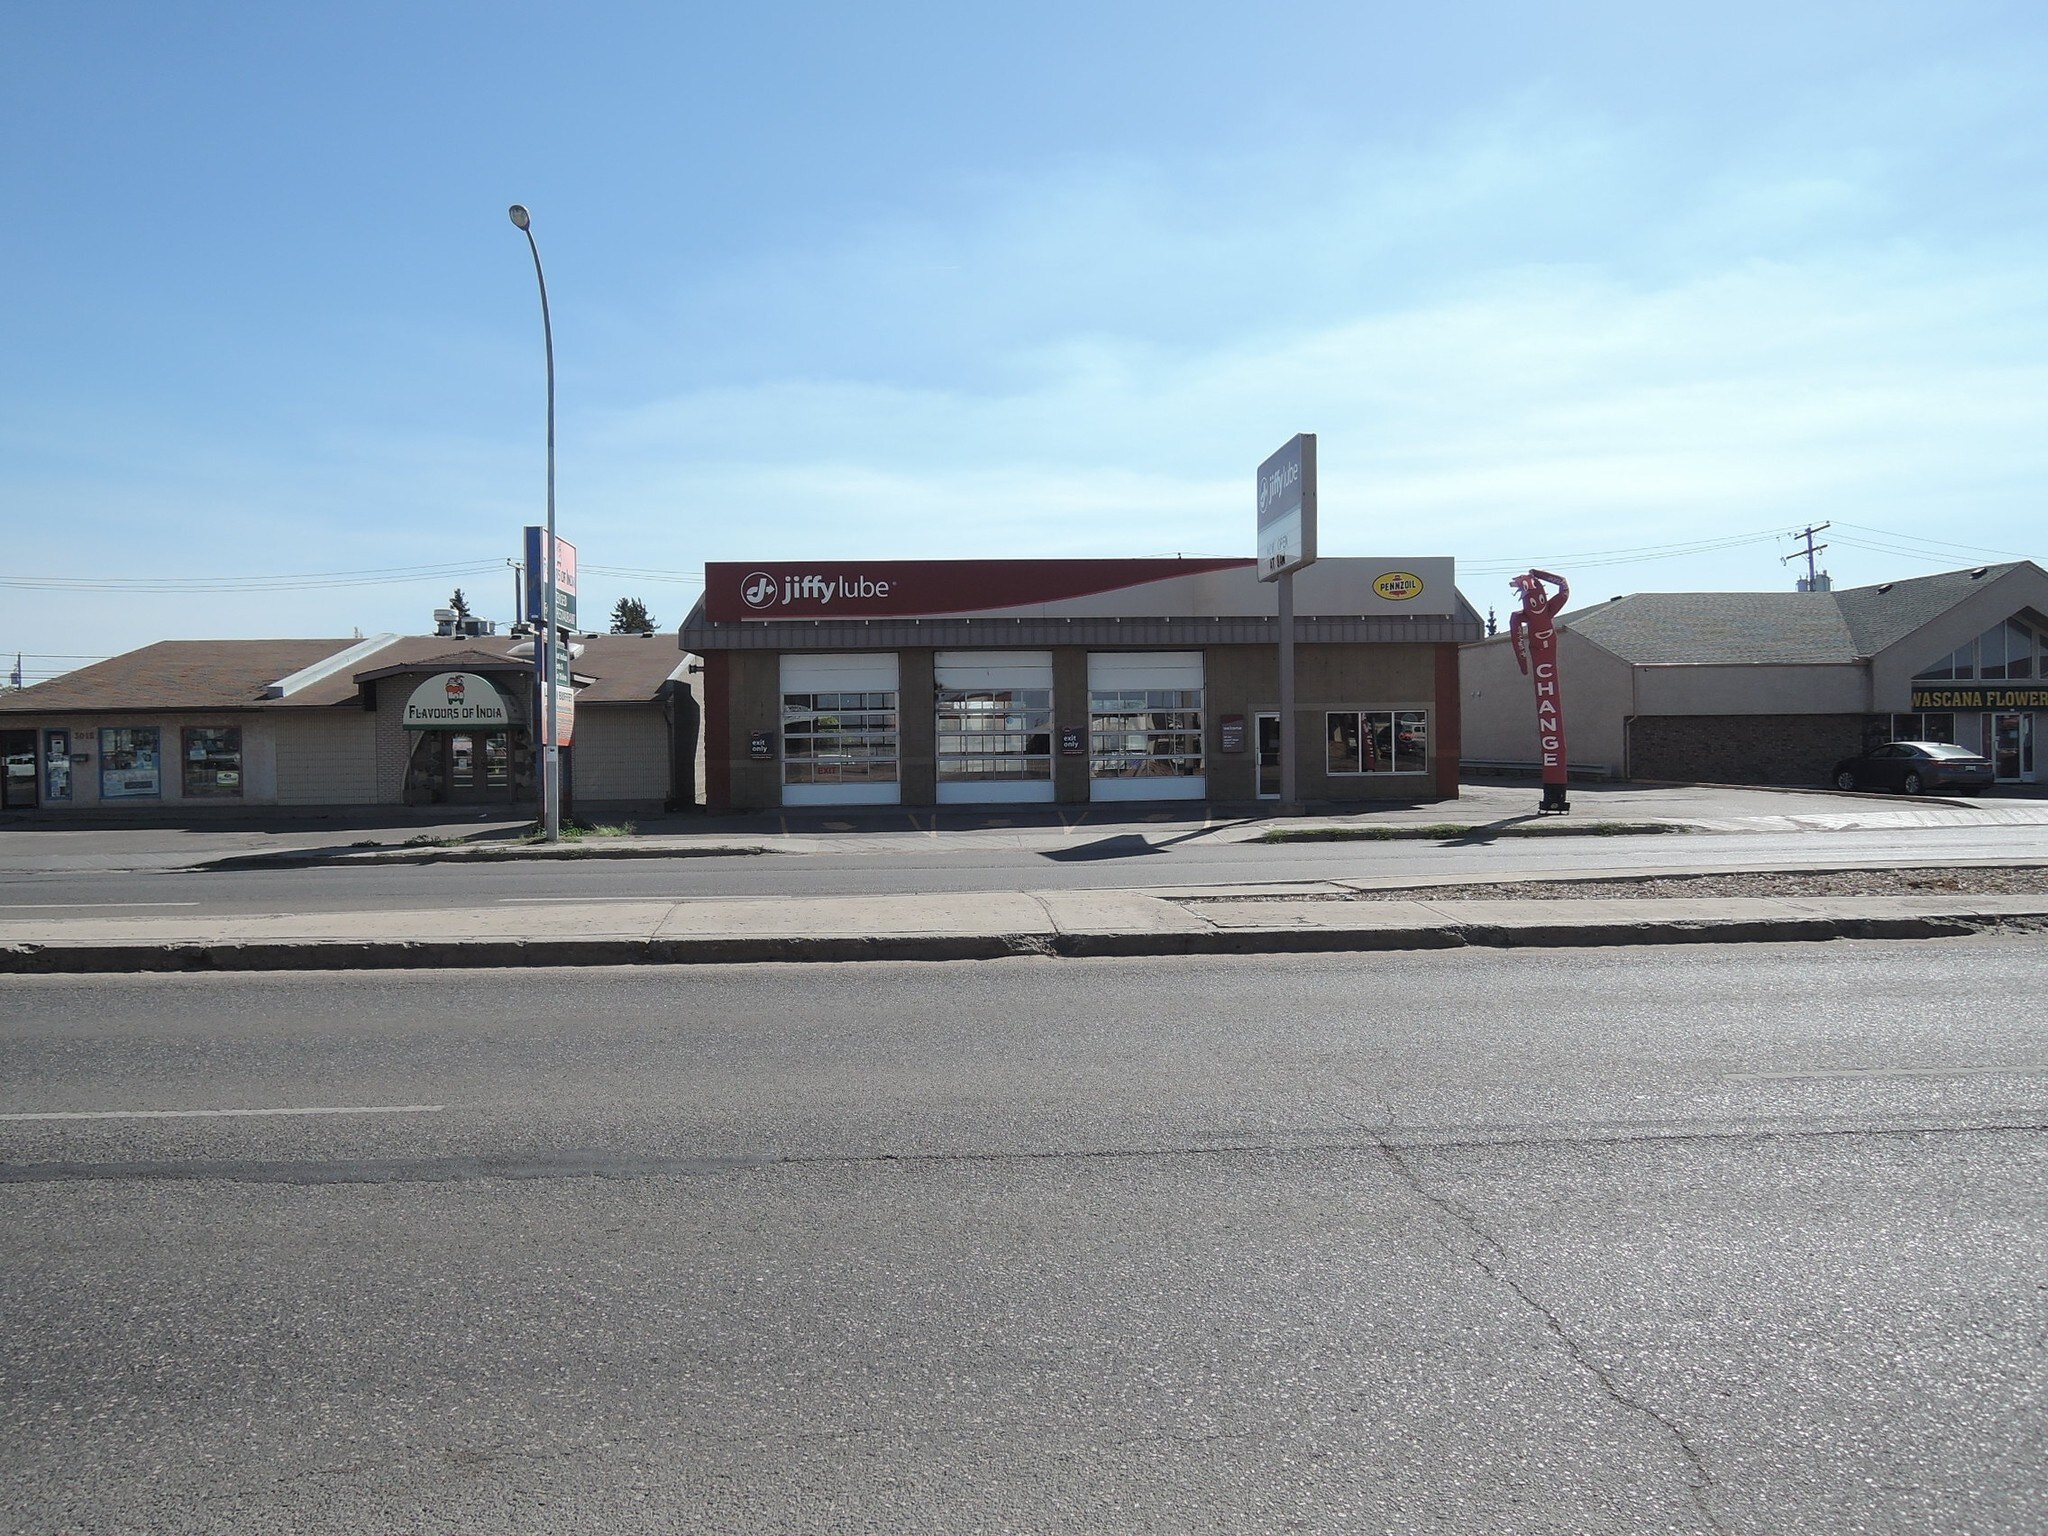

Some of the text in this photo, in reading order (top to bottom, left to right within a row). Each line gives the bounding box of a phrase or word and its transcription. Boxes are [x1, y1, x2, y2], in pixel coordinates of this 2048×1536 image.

[781, 575, 890, 605] jiffy lube
[1379, 580, 1417, 592] PENNZOIL
[1912, 692, 1983, 707] WASCANA
[409, 705, 502, 719] FLAVOURS OF INDIA
[1536, 663, 1559, 767] CHANGE
[752, 745, 767, 753] only
[818, 767, 835, 775] EXIT
